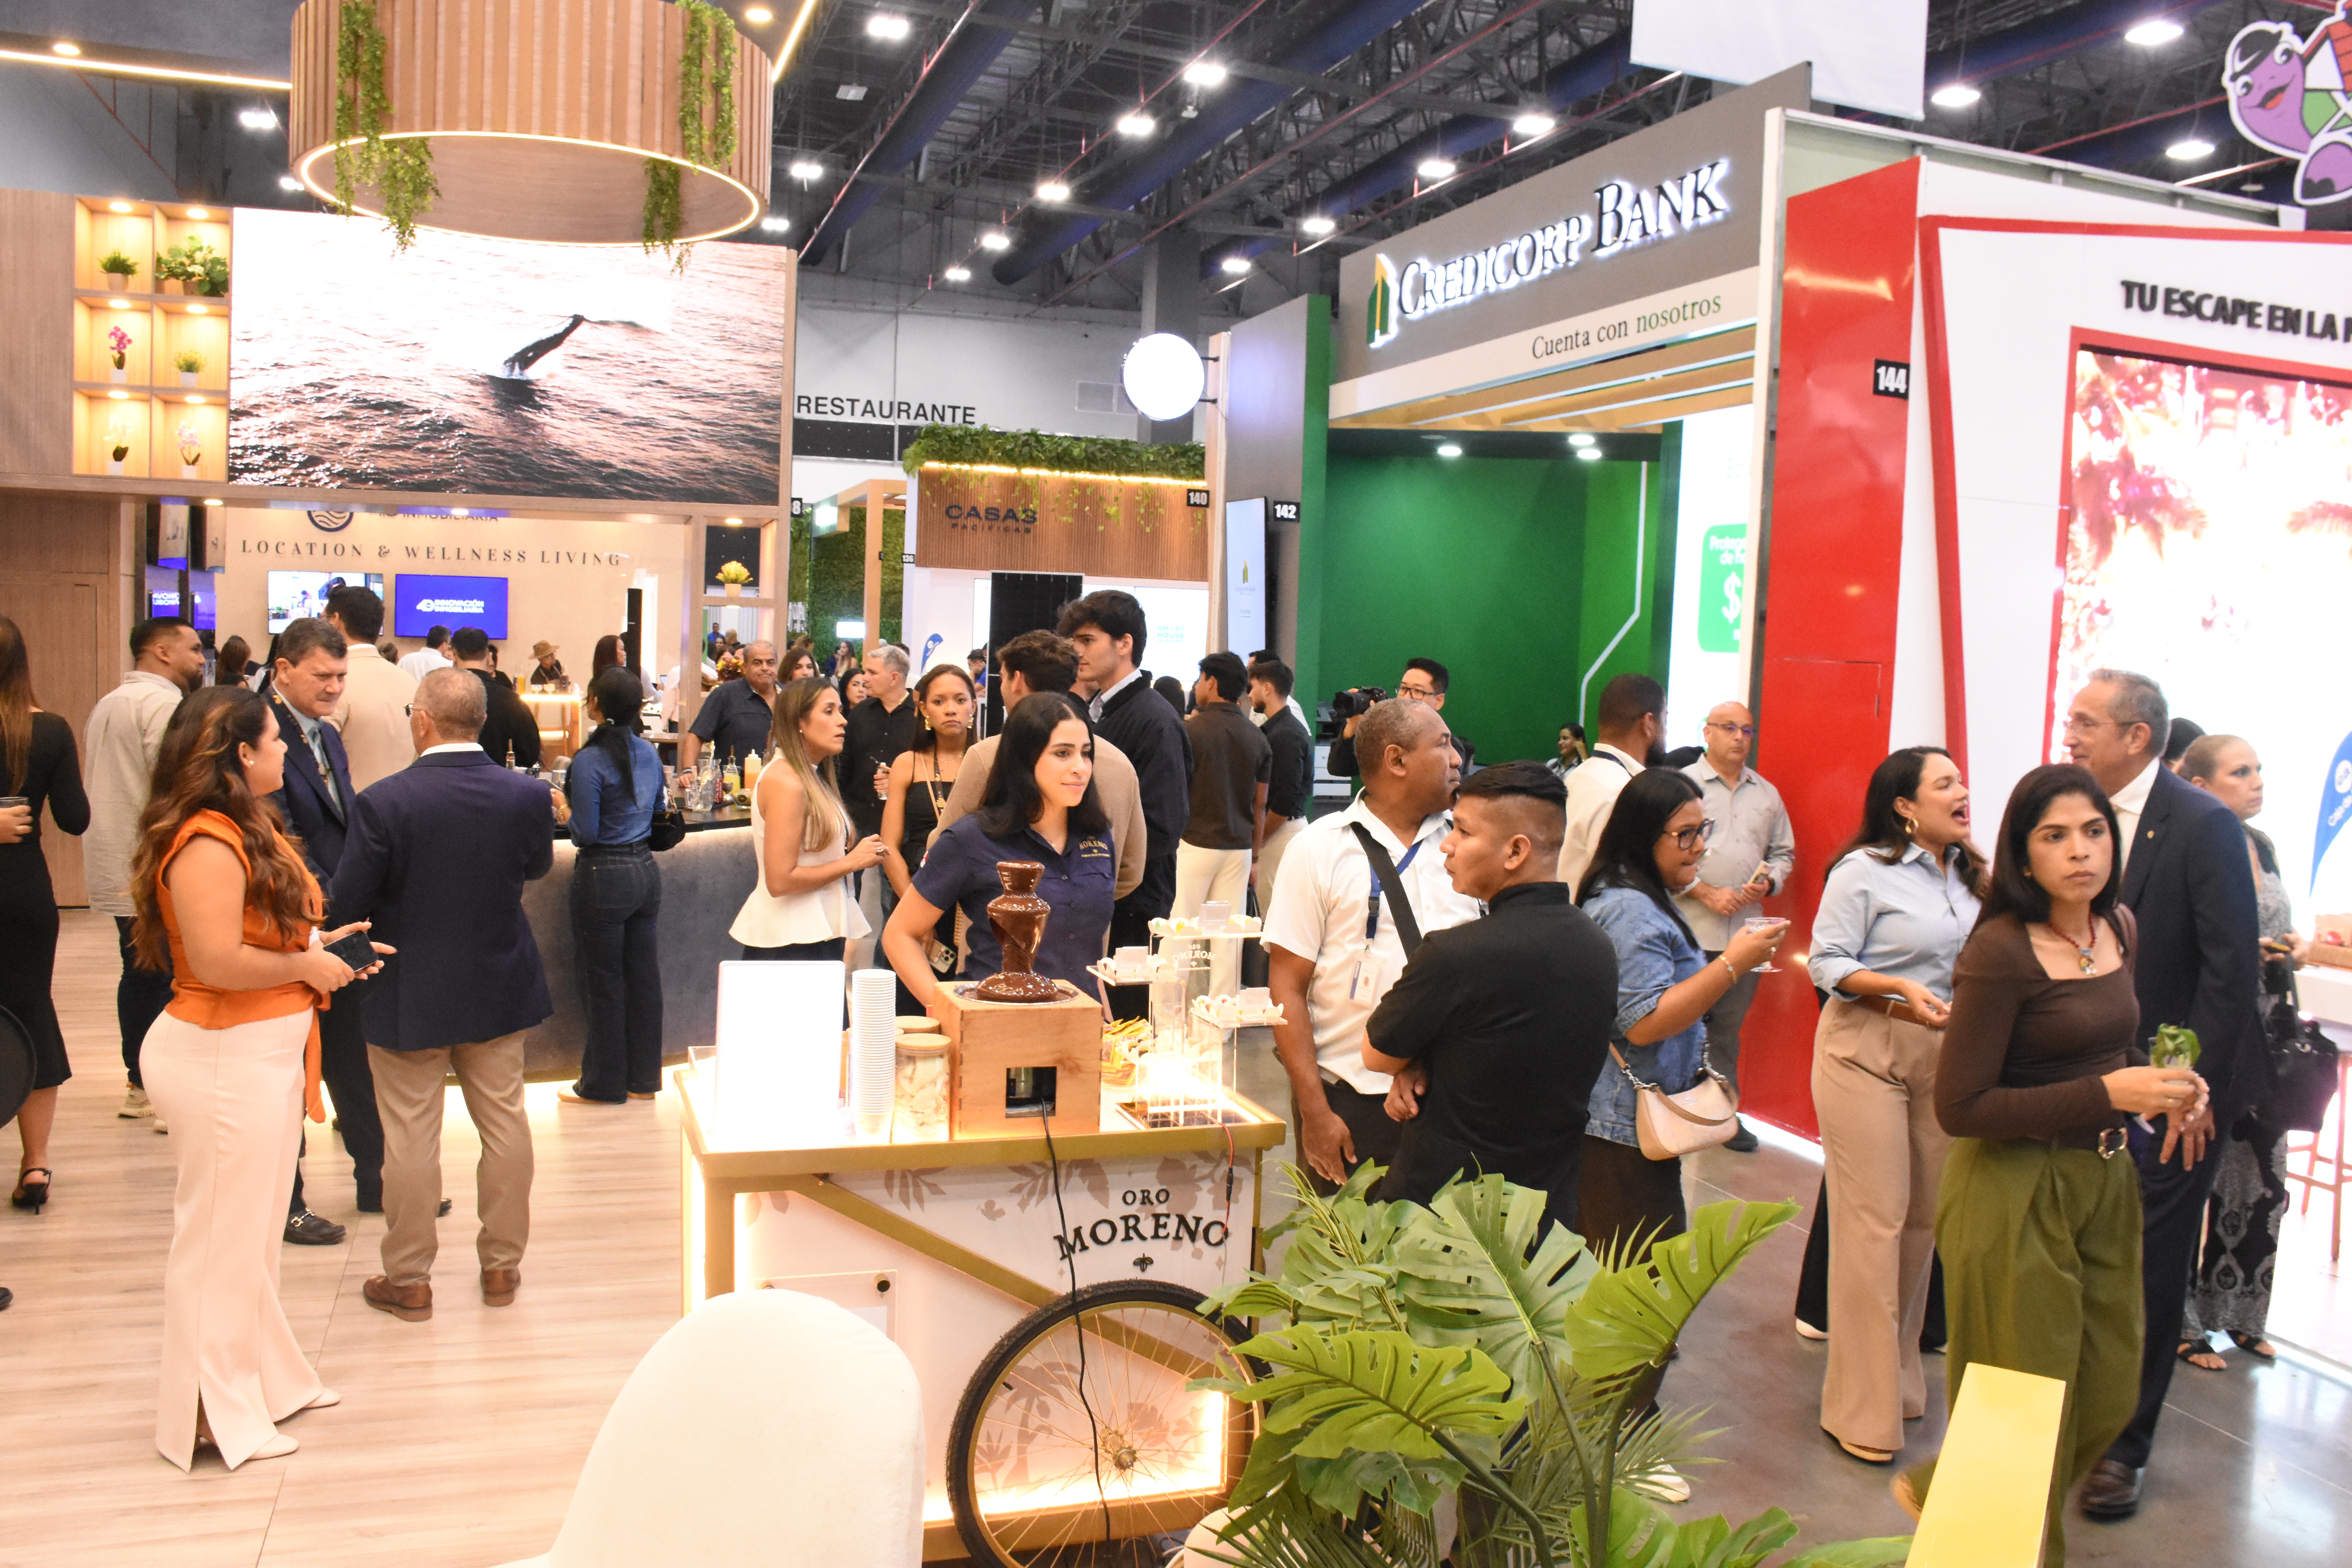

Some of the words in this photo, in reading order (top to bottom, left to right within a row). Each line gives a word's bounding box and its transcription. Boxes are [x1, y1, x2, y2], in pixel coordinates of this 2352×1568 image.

[1591, 159, 1729, 257] BANK
[2121, 280, 2158, 312] TU
[2163, 287, 2262, 328] ESCAPE
[2267, 305, 2302, 334] EN
[2306, 310, 2338, 341] LA
[1532, 329, 1590, 358] Cuenta
[1597, 320, 1628, 342] con
[1636, 296, 1721, 334] nosotros
[1876, 365, 1907, 394] 144
[797, 396, 976, 425] RESTAURANTE
[1189, 492, 1208, 505] 140
[1274, 505, 1297, 519] 142
[946, 505, 1037, 523] CASAS
[241, 539, 362, 557] LOCATION
[378, 544, 390, 558] &
[404, 546, 526, 563] WELLNESS
[541, 550, 620, 566] LIVING
[902, 554, 914, 563] 136
[1122, 1188, 1170, 1206] ORO
[1053, 1212, 1229, 1261] MORENO
